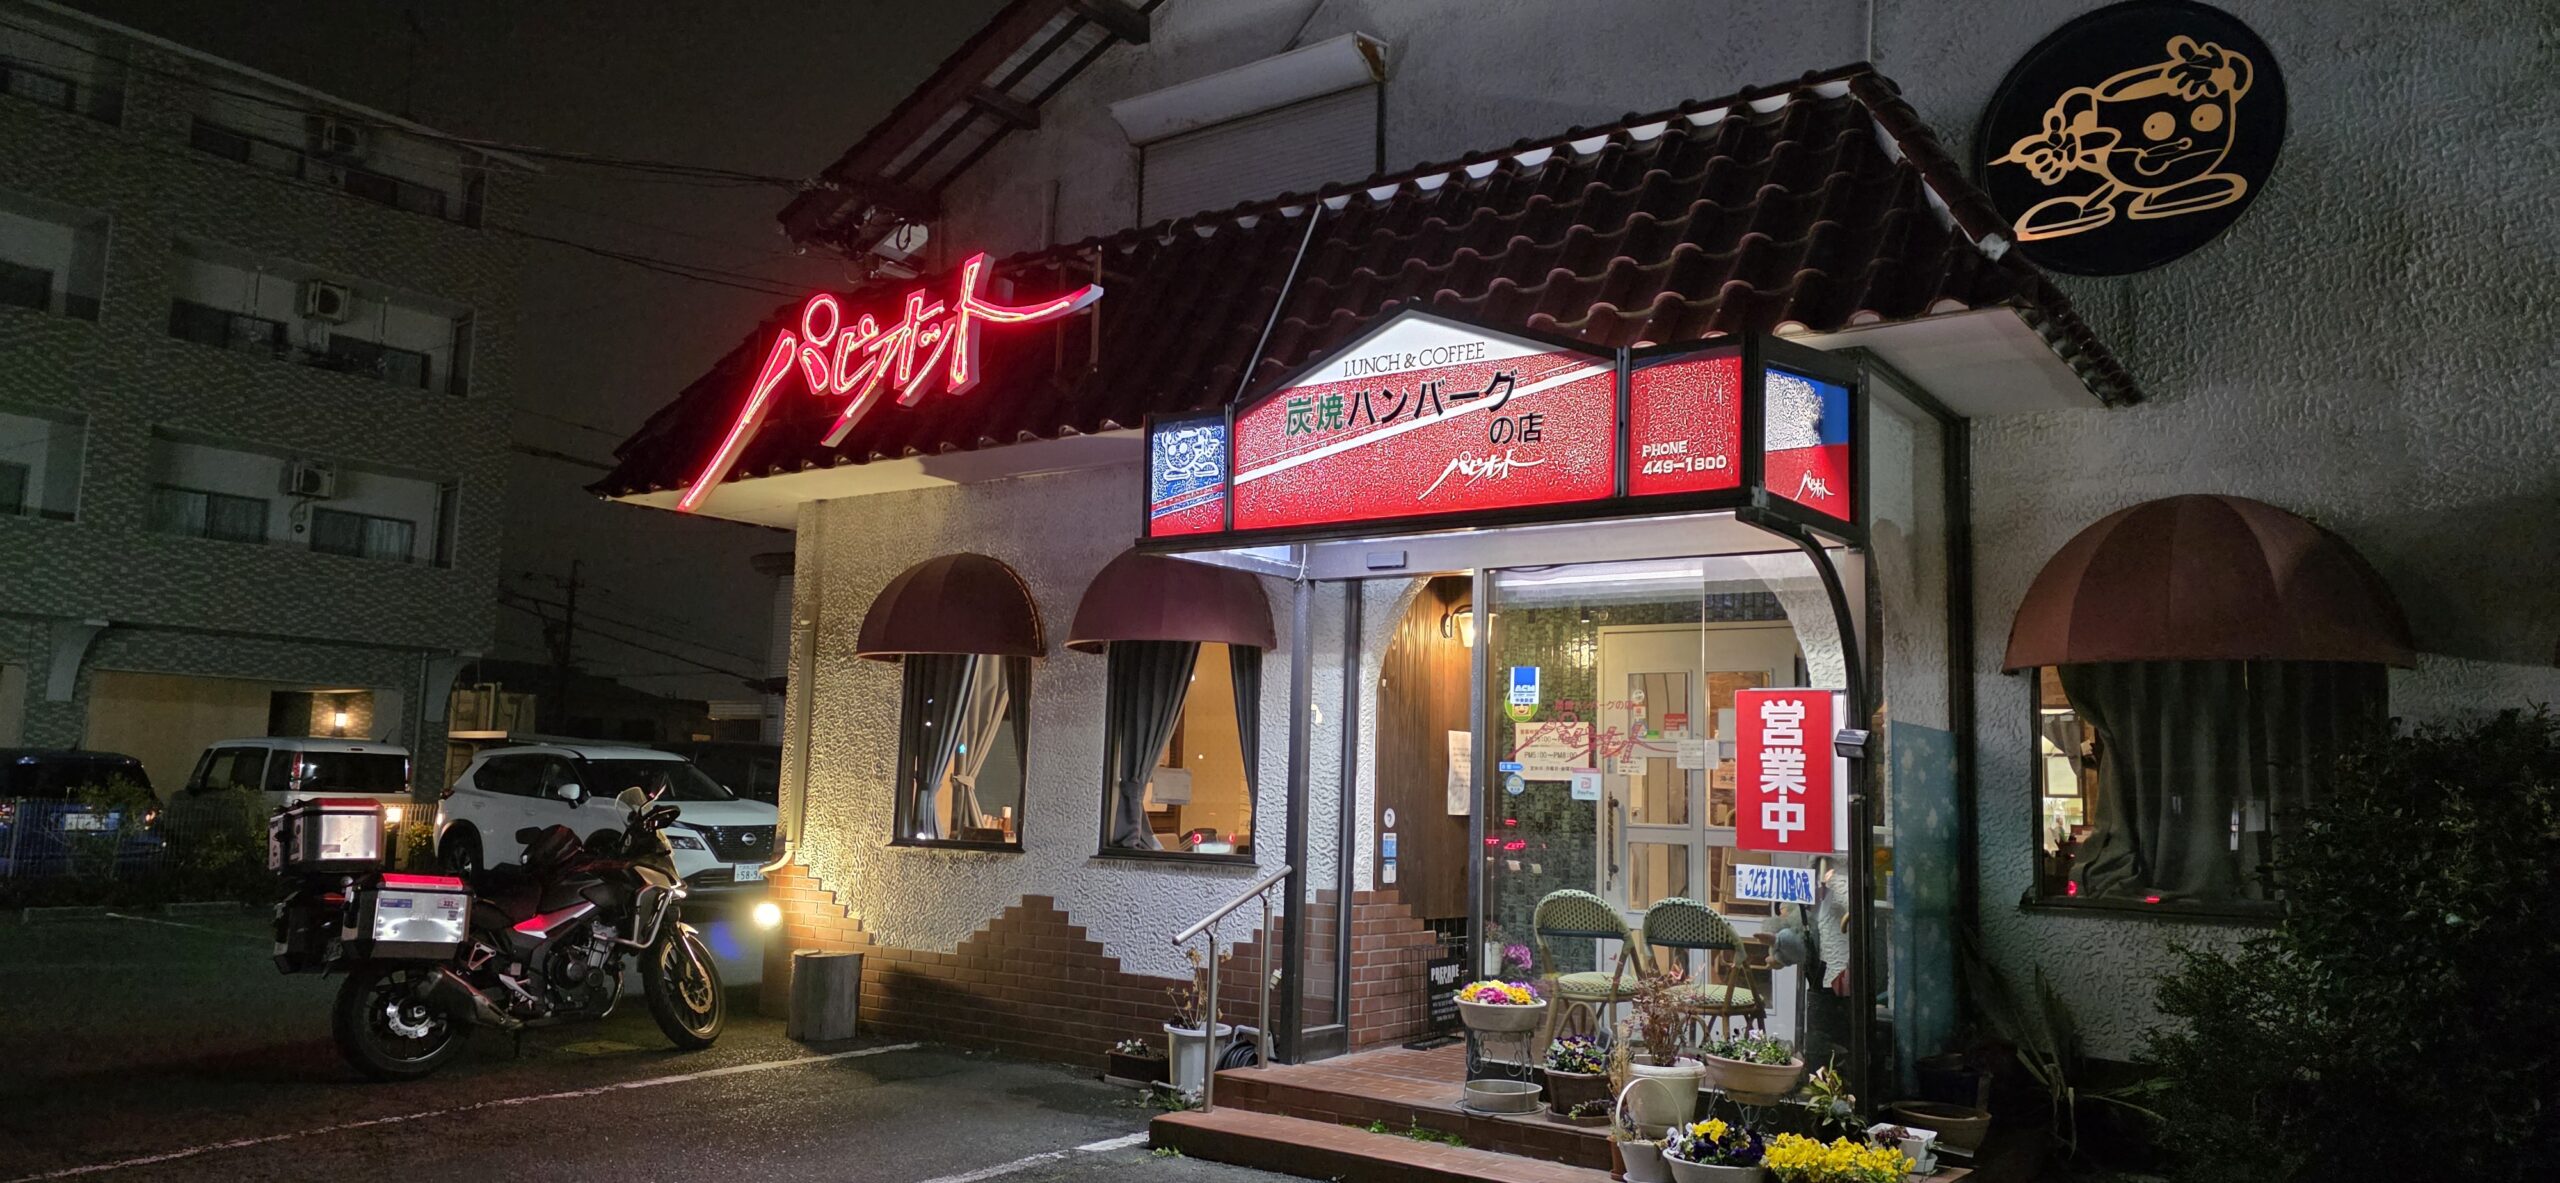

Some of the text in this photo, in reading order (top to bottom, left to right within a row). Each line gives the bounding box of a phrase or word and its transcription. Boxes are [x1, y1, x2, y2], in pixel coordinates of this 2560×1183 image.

[1343, 342, 1486, 378] LUNCH & COFFEE
[1286, 369, 1519, 437] 炭焼ハンバーグ
[1488, 412, 1544, 446] の店
[1641, 440, 1689, 458] PHONE
[1641, 455, 1728, 475] 449-1800
[1760, 700, 1807, 843] 営業中
